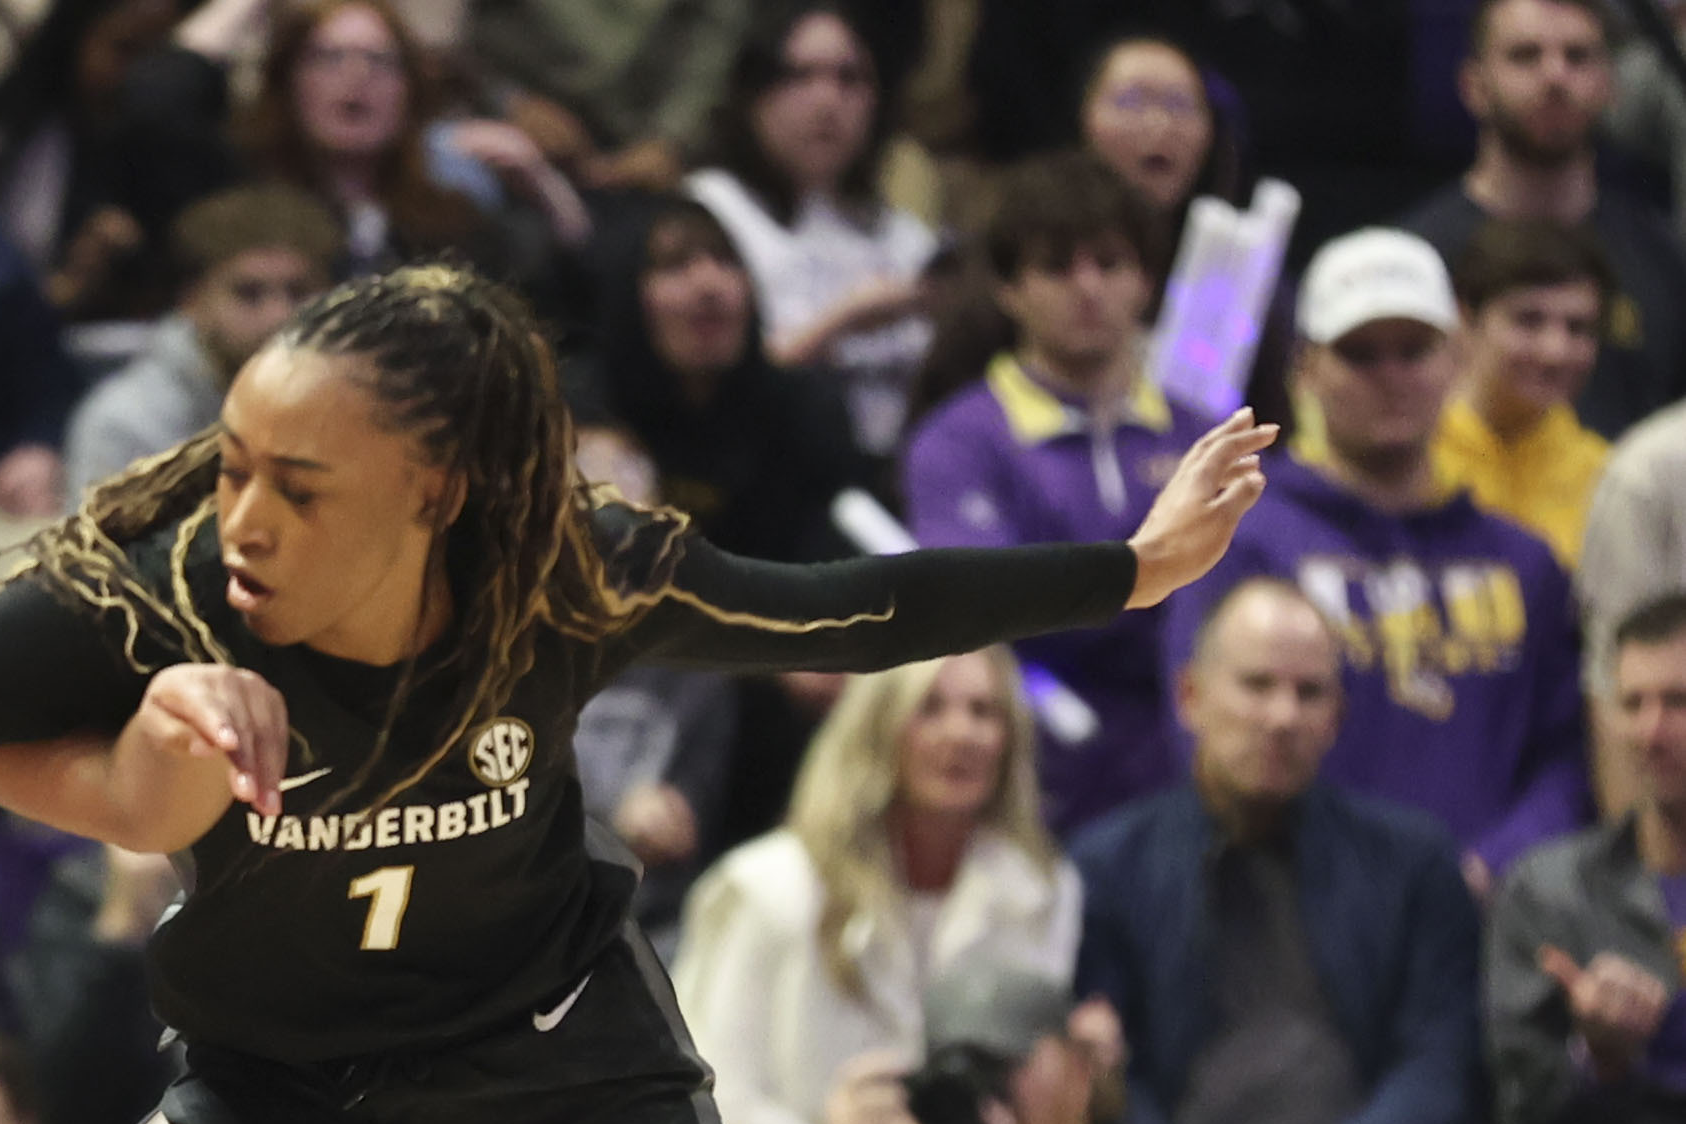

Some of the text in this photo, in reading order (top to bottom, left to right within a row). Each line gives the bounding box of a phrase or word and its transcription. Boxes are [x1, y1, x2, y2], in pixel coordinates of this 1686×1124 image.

[475, 722, 530, 783] SEC
[246, 778, 530, 851] VANDERBILT
[347, 864, 415, 951] 1
